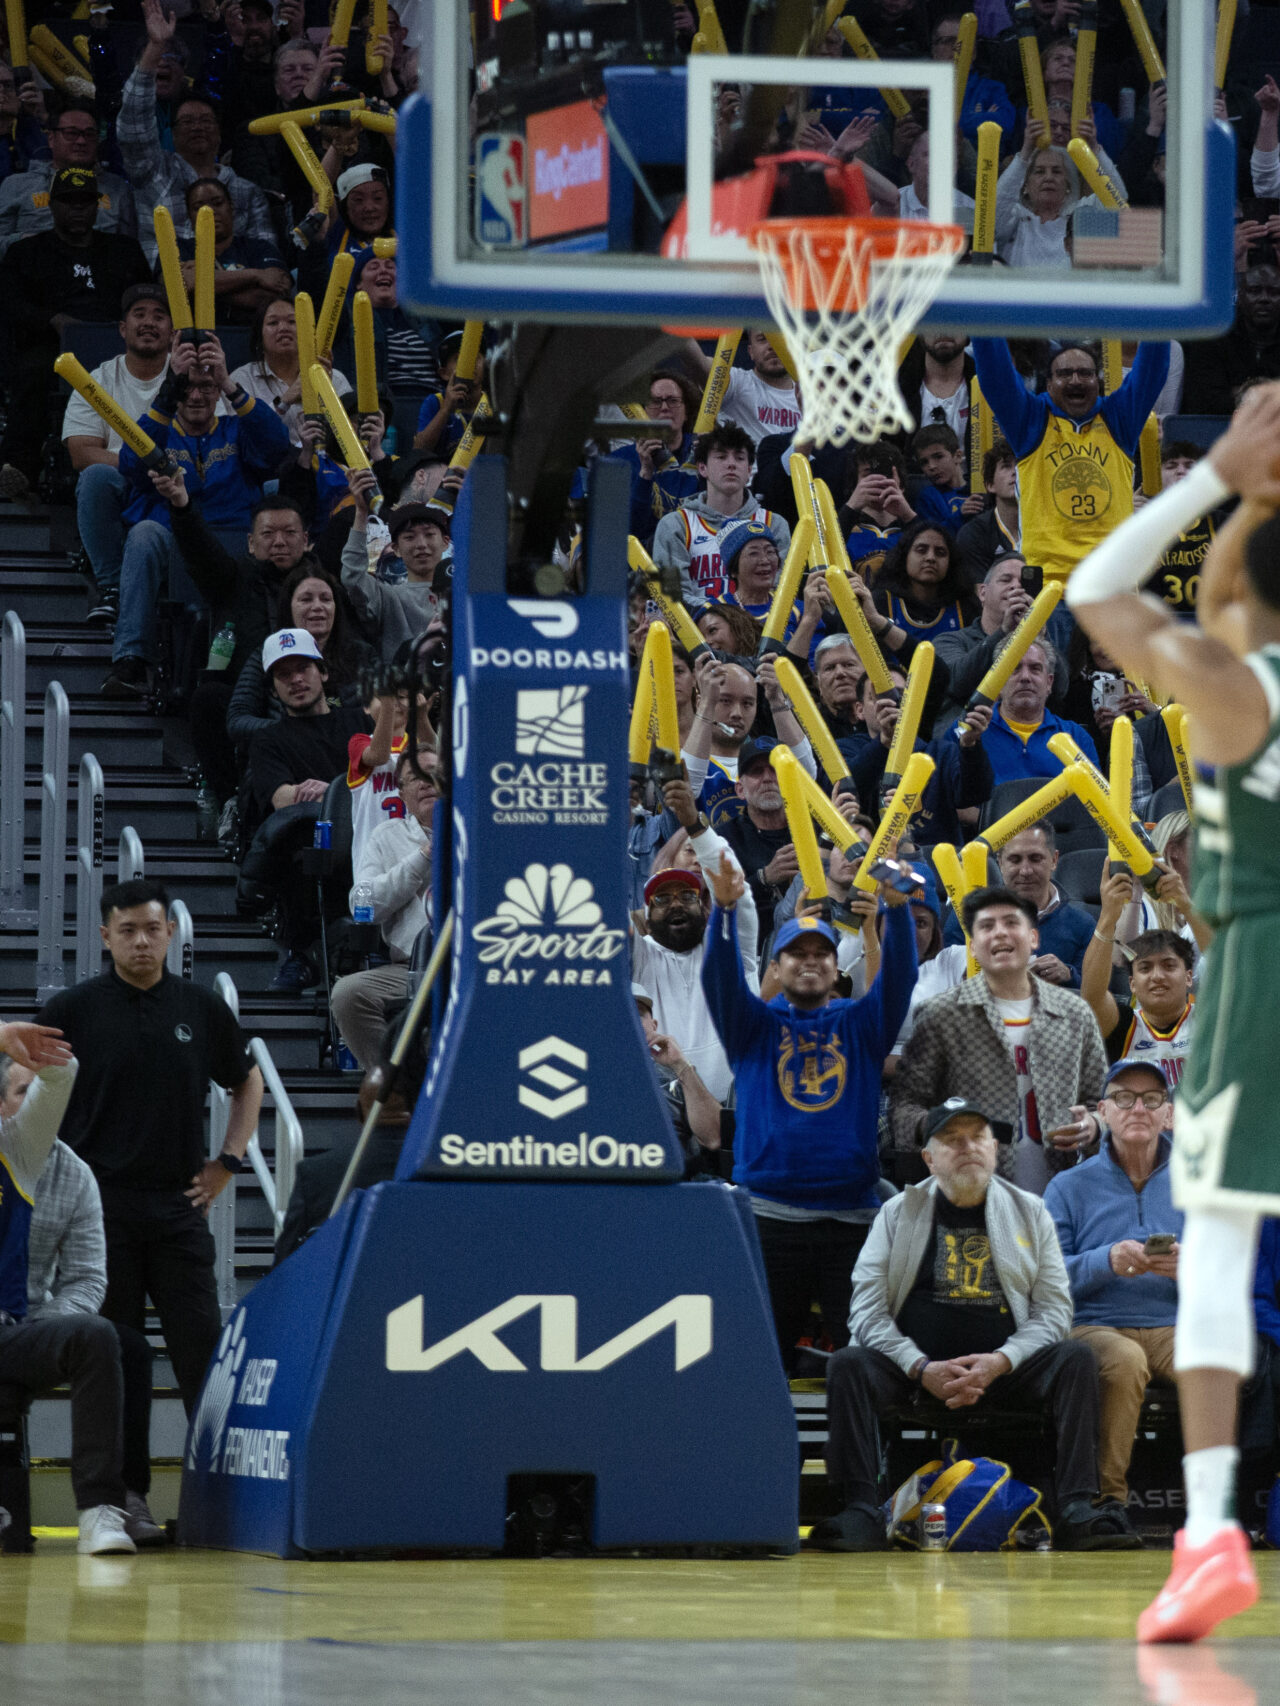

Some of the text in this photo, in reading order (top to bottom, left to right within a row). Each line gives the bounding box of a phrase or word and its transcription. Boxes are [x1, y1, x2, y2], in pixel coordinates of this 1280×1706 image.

[703, 364, 723, 415] WARRIORS
[758, 406, 801, 427] WARRI
[1045, 442, 1109, 469] TOWN
[1071, 494, 1096, 517] 23
[471, 648, 628, 670] DOORDASH
[491, 762, 608, 786] CACHE
[491, 786, 609, 810] CREEK
[706, 787, 737, 807] GOLDE
[493, 812, 609, 825] CASINO RESORT
[471, 914, 626, 970] Sports
[486, 969, 612, 985] BAY AREA
[440, 1132, 665, 1168] SentinelOne
[237, 1358, 279, 1406] KAISER
[222, 1427, 291, 1481] PERMANENTE
[1127, 1489, 1187, 1508] ASE
